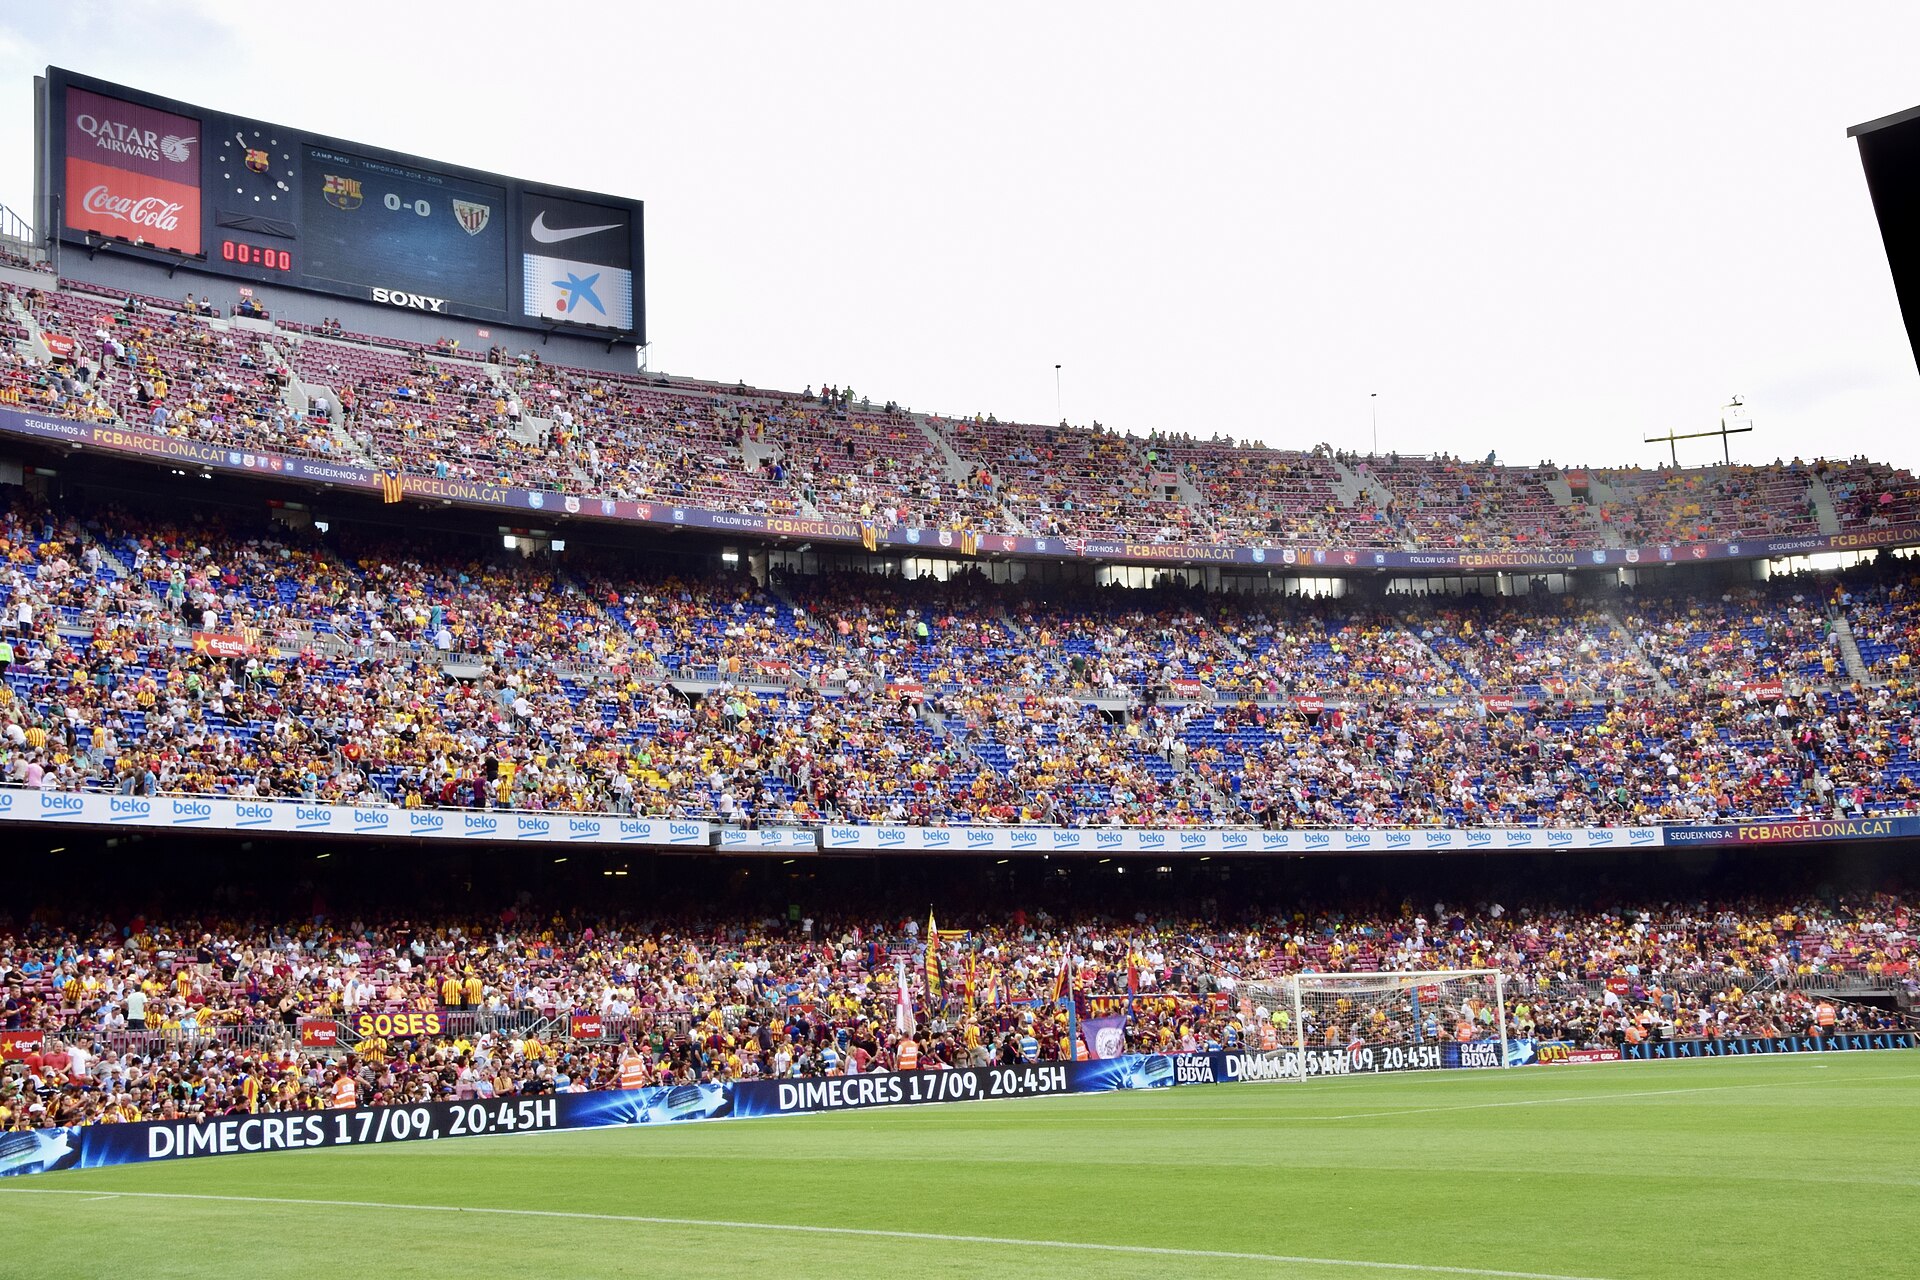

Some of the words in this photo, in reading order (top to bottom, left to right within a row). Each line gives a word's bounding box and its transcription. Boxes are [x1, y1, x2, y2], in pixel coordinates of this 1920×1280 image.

[76, 114, 158, 150] QATAR
[96, 137, 160, 162] AIRWAYS
[311, 151, 332, 160] CAMP
[334, 156, 350, 164] NOU
[362, 162, 404, 176] TEMPORADA
[383, 193, 431, 217] 0-0
[223, 241, 291, 271] 00:00
[372, 287, 444, 313] SONY
[24, 419, 79, 435] SEGUEIX-NOS
[80, 429, 88, 437] A:
[93, 429, 226, 463] FCBARCELONA.CAT
[304, 465, 352, 480] SEGUEIX-NOS
[356, 473, 367, 482] A:
[373, 473, 508, 503] FARCELONA.CAT
[712, 515, 741, 525] FOLLOW
[742, 518, 752, 526] US
[753, 519, 763, 528] AT:
[1126, 545, 1235, 560] FCBARCELONA.CAT
[1768, 541, 1816, 551] SEGUEIX-NOS
[1410, 556, 1435, 564] FOLLOW
[1437, 556, 1445, 564] US
[1447, 556, 1456, 564] AT:
[1459, 553, 1575, 566] FCBARCELONA.COM
[211, 639, 243, 651] Estrella
[1301, 700, 1324, 708] Estrella
[41, 793, 84, 809] beko
[110, 797, 151, 813] beko
[173, 800, 211, 816] beko
[236, 804, 273, 818] beko
[296, 807, 332, 821] beko
[354, 809, 389, 824] beko
[410, 812, 444, 827] beko
[464, 815, 497, 828] beko
[518, 817, 550, 830] beko
[569, 819, 601, 832] beko
[620, 821, 651, 834] beko
[670, 823, 699, 836] beko
[725, 830, 747, 839] beko
[760, 830, 782, 840] beko
[793, 831, 814, 840] beko
[832, 827, 860, 839] beko
[878, 828, 905, 840] beko
[923, 829, 950, 841] beko
[967, 830, 994, 842] beko
[1011, 831, 1037, 842] beko
[1054, 831, 1080, 843] beko
[1097, 832, 1123, 843] beko
[1139, 832, 1165, 843] beko
[1180, 833, 1206, 843] beko
[1222, 833, 1248, 843] beko
[1263, 833, 1289, 844] beko
[1304, 833, 1330, 843] beko
[1345, 832, 1370, 843] beko
[1386, 832, 1411, 842] beko
[1426, 831, 1452, 842] beko
[1466, 830, 1492, 841] beko
[1507, 830, 1532, 841] beko
[1547, 830, 1573, 841] beko
[1587, 829, 1613, 840] beko
[1629, 828, 1655, 839] beko
[1670, 830, 1723, 841] SEGUEIX-NOS
[1725, 830, 1733, 839] A:
[1739, 820, 1892, 840] FCBARCELONA.CAT
[358, 1013, 441, 1036] SOSES
[1469, 1044, 1494, 1053] LIGA
[1185, 1056, 1210, 1067] LIGA
[1383, 1046, 1441, 1069] 20:45H
[1461, 1053, 1499, 1066] BBVA
[1177, 1067, 1214, 1082] BBVA
[778, 1076, 902, 1110] DIMECRES
[909, 1071, 984, 1100] 17/09,
[990, 1066, 1067, 1095] 20:45H
[148, 1115, 325, 1158] DIMECRES
[334, 1107, 439, 1143] 17/09,
[450, 1099, 558, 1134] 20:45H
